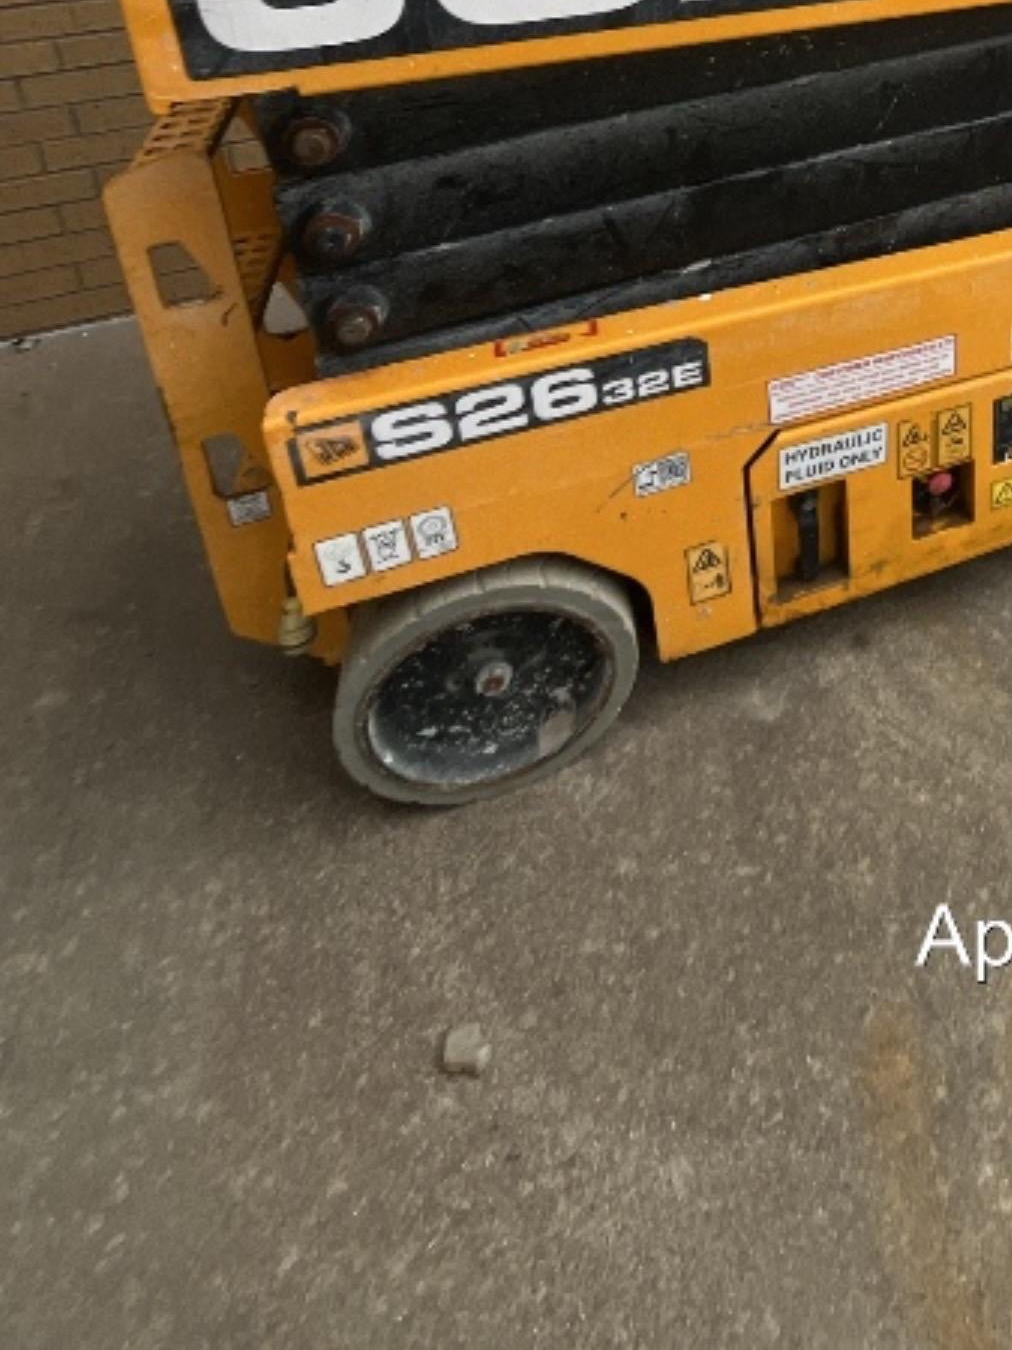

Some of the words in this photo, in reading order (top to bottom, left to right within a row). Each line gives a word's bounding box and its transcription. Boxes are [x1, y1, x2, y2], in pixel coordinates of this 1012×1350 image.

[785, 428, 883, 466] HYDRAULIC
[785, 461, 835, 484] FLUID
[840, 446, 883, 469] ONLY
